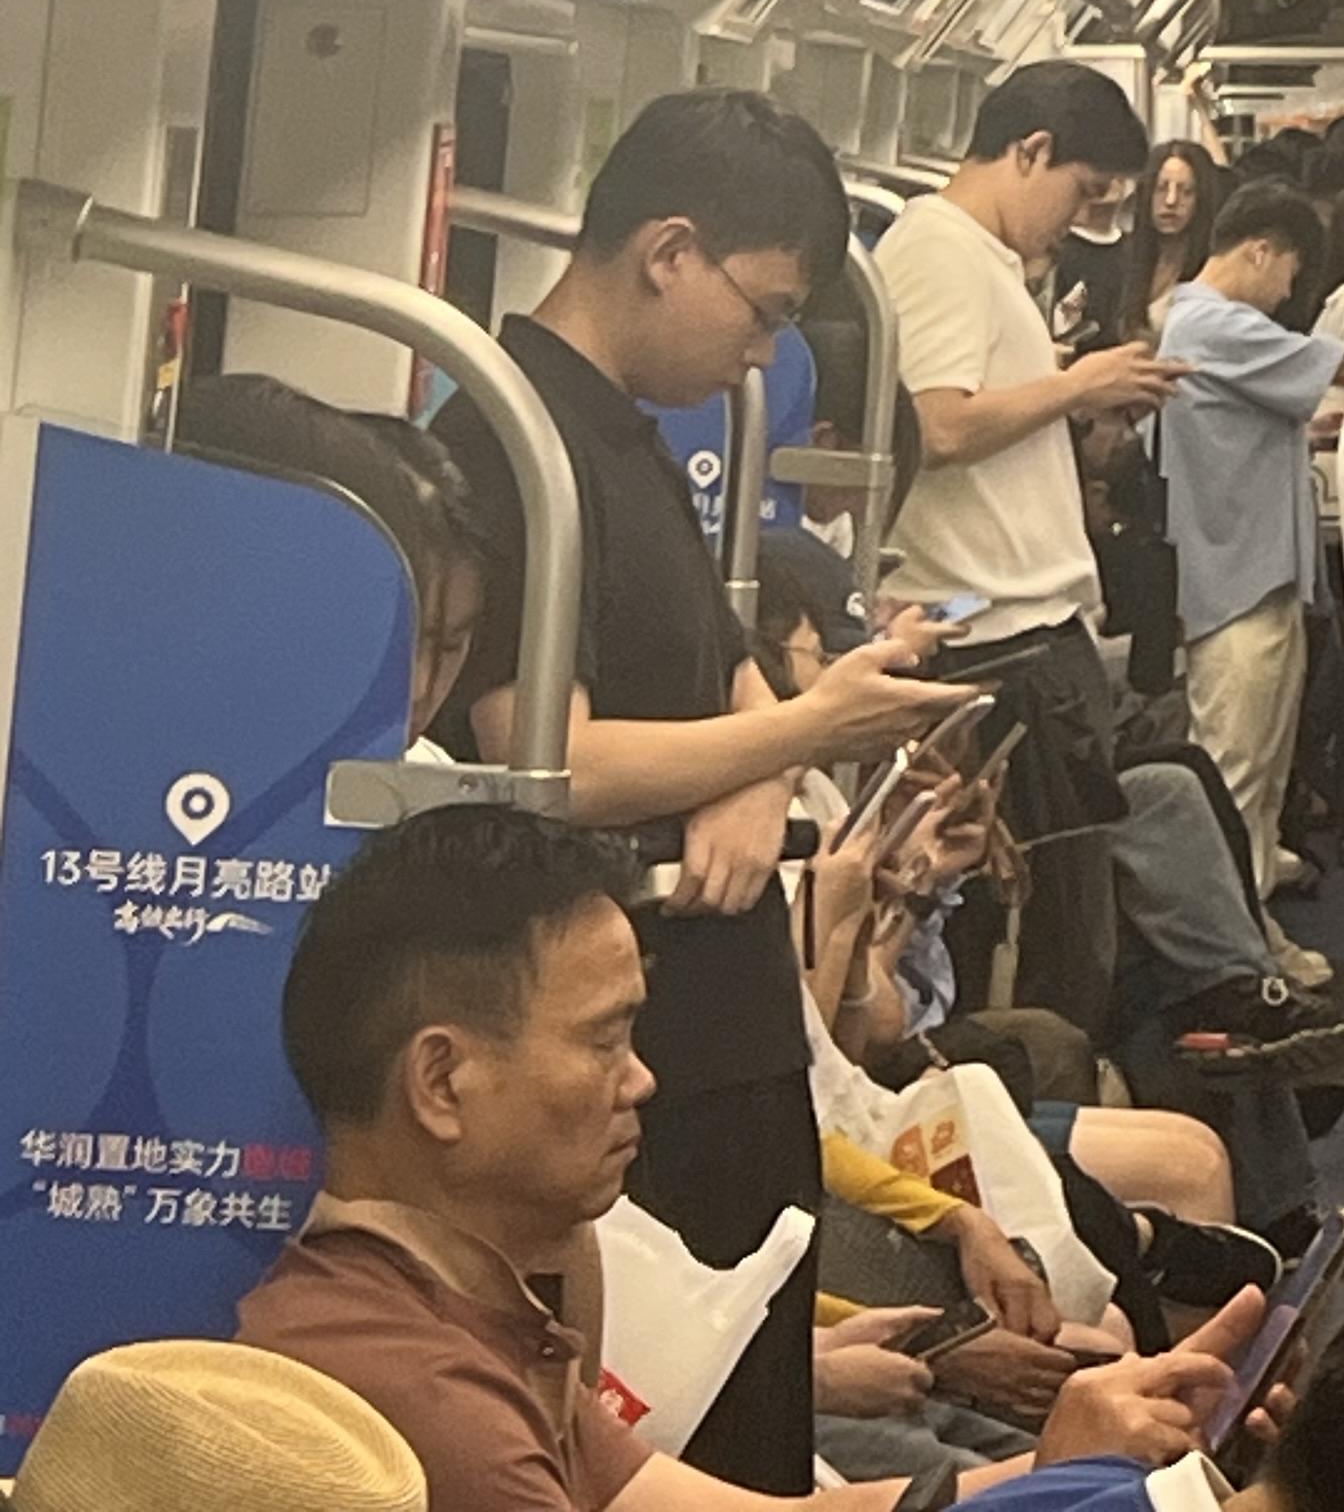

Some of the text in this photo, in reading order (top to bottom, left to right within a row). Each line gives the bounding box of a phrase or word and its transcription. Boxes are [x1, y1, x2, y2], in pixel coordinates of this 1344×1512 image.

[40, 848, 331, 902] 13号线月亮路站
